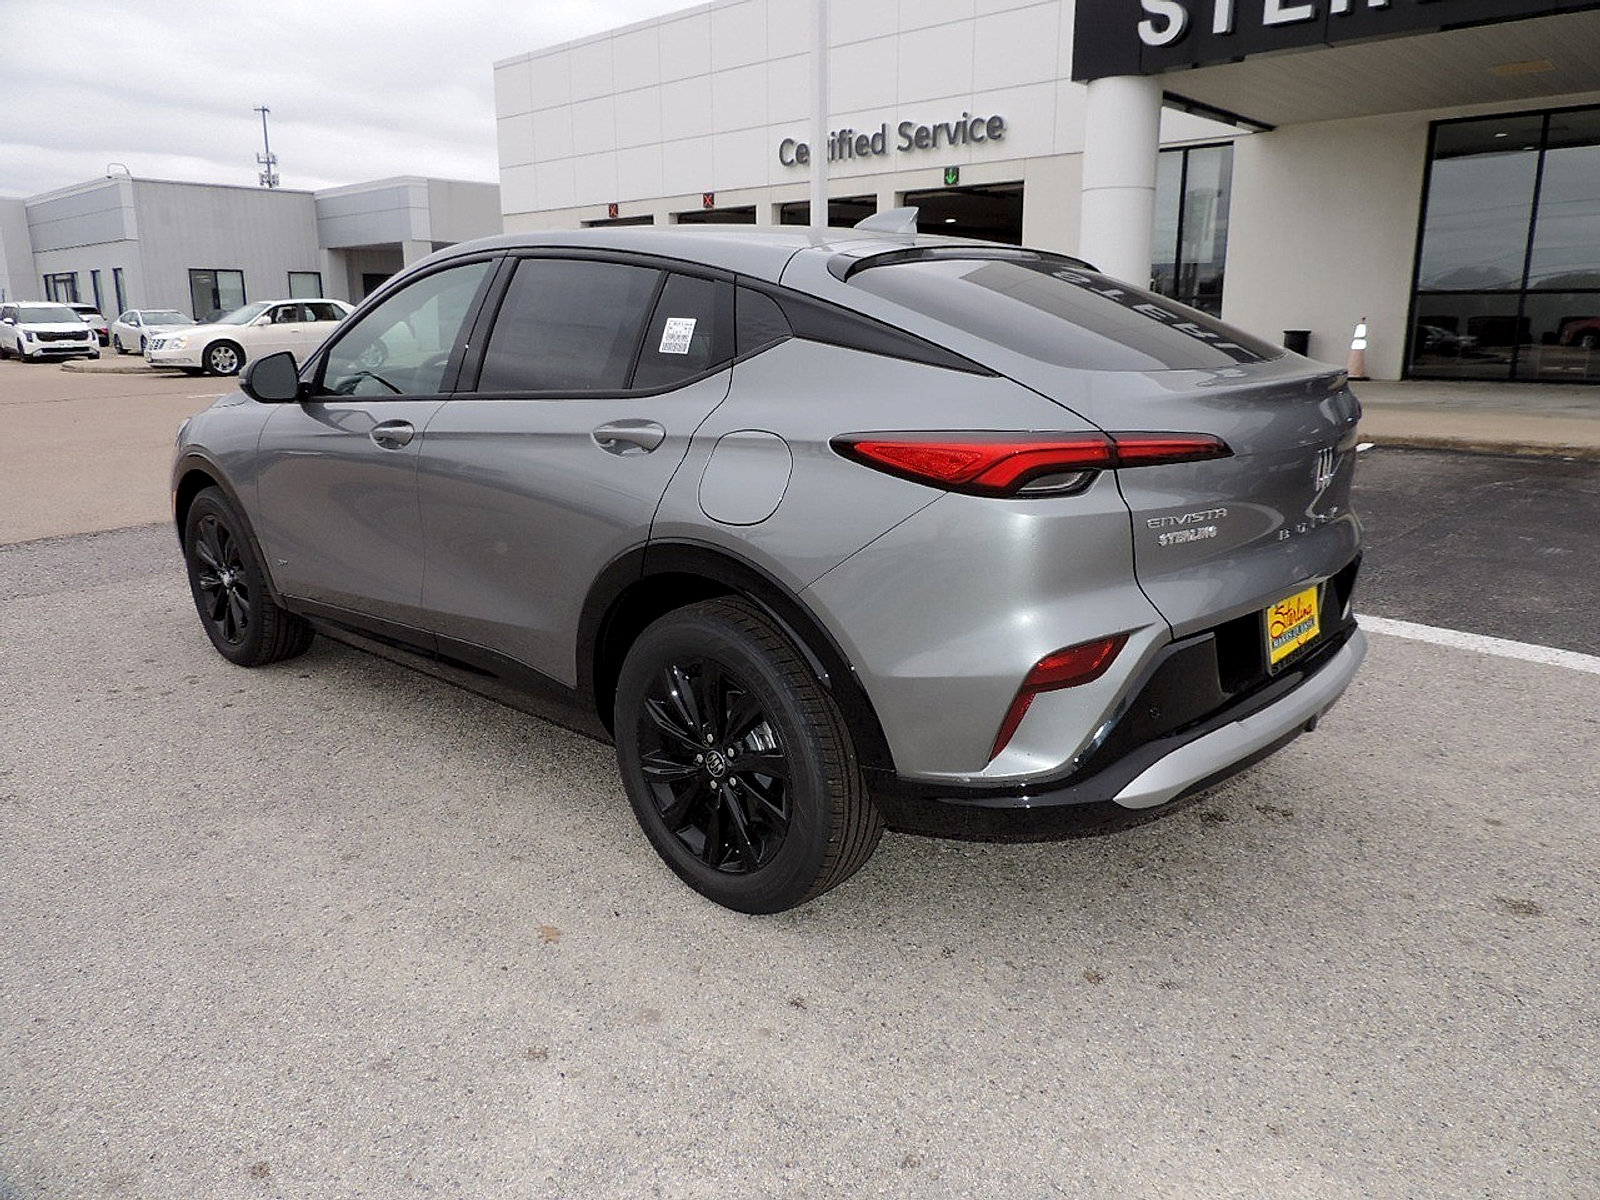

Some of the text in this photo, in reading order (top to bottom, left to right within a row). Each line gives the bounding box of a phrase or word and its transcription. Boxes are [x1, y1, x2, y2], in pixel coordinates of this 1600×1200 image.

[779, 112, 1006, 167] Ceified Service
[1146, 507, 1228, 529] ENVISTA
[1158, 525, 1218, 546] STERLING
